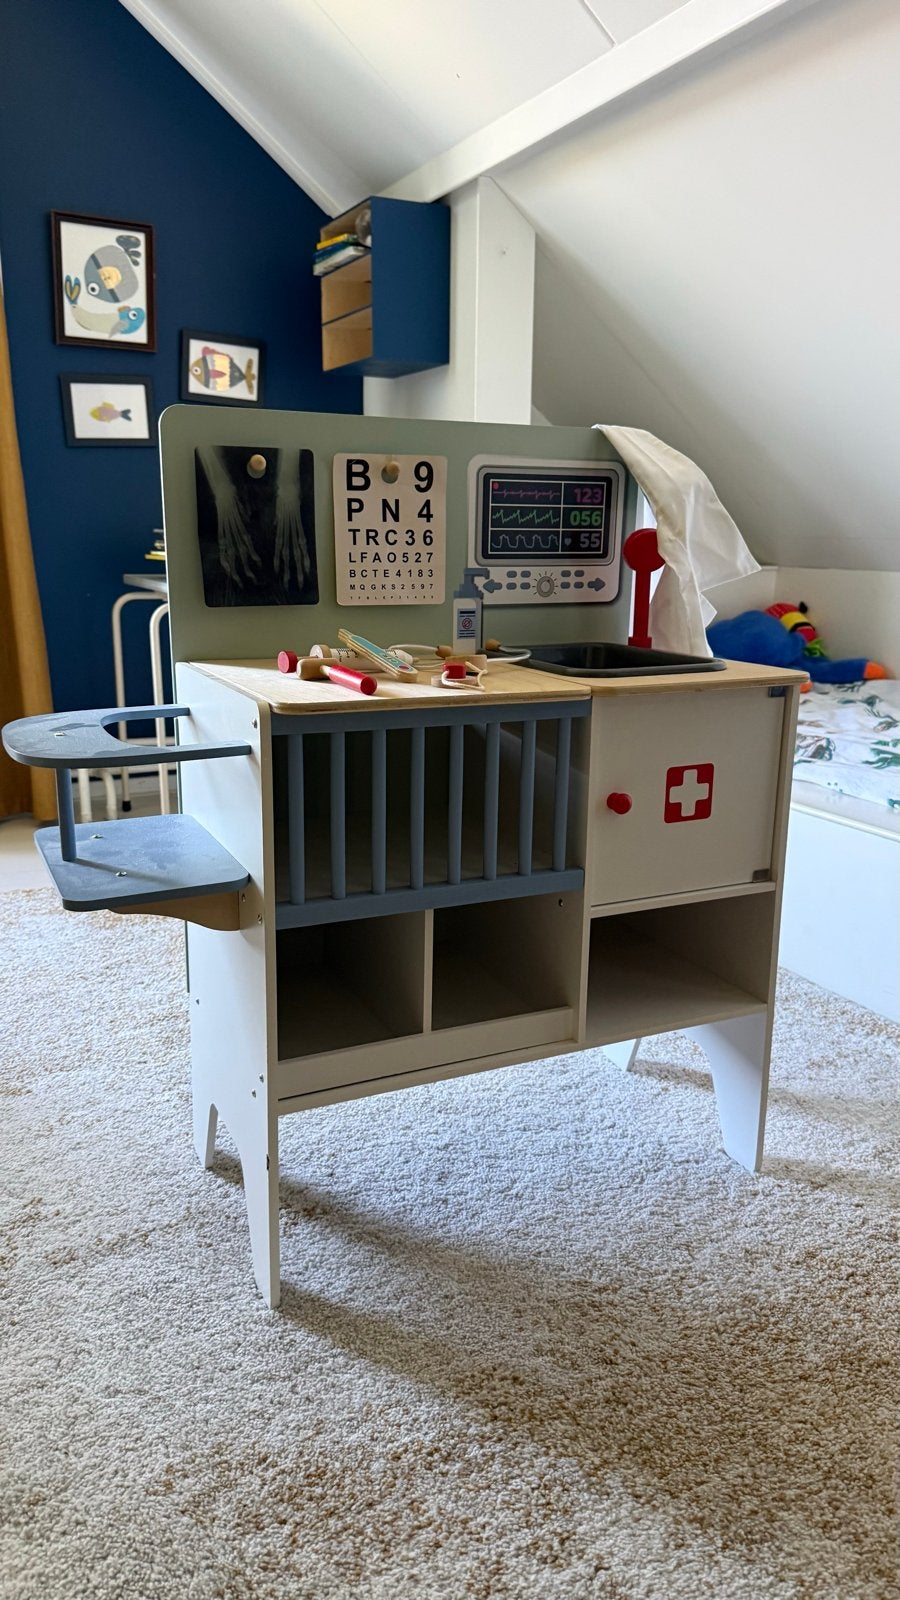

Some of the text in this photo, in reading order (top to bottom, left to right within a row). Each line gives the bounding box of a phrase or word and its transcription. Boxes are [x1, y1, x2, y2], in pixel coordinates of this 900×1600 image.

[346, 458, 434, 493] B 9
[573, 487, 603, 504] 123
[346, 497, 434, 523] P N 4
[569, 510, 602, 526] 056
[579, 532, 601, 548] 55
